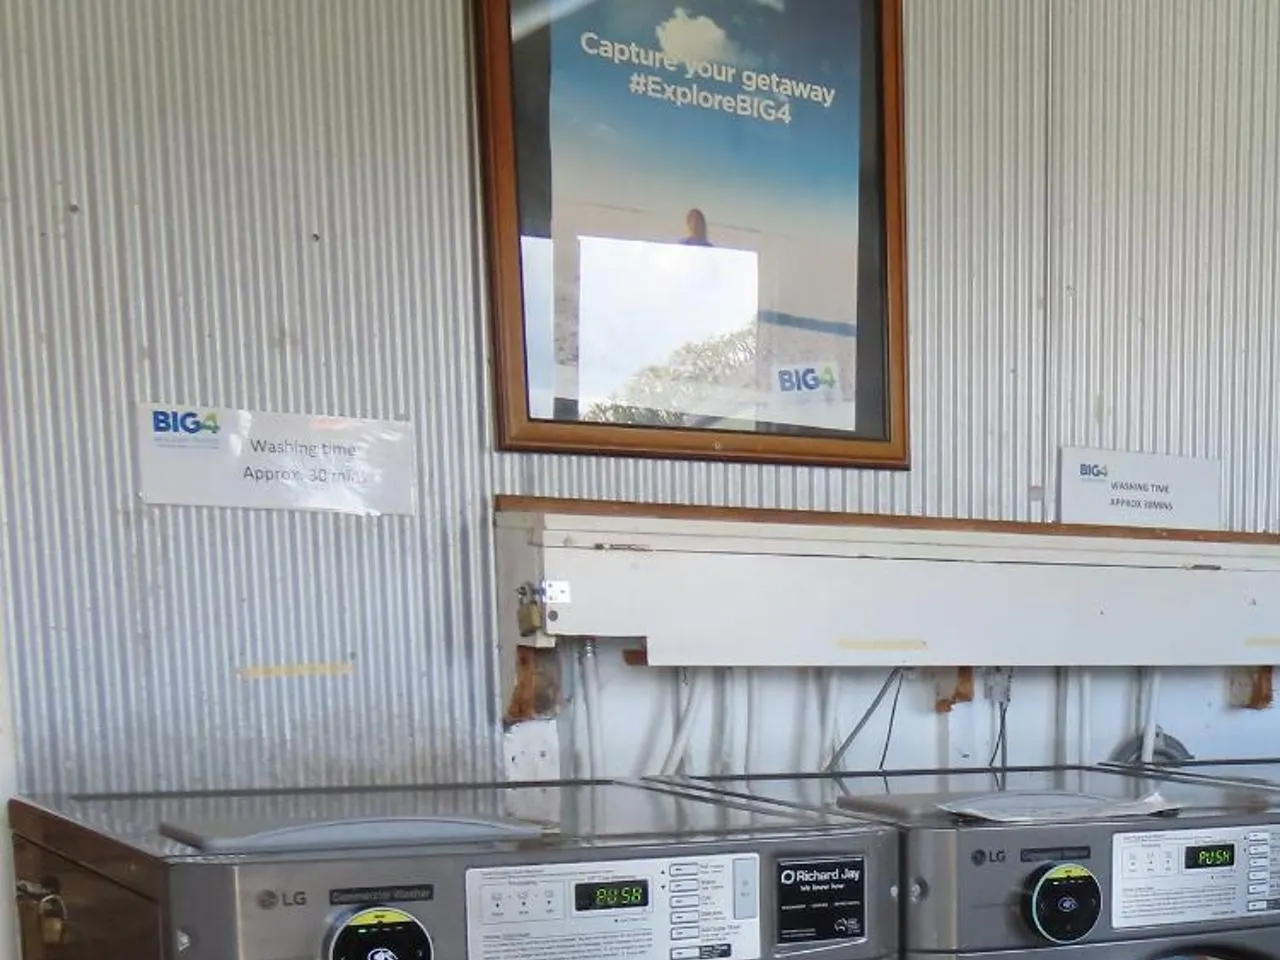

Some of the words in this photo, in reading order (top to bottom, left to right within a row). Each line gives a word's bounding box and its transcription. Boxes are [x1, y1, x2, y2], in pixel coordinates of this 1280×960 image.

[580, 31, 677, 71] Capture
[682, 57, 736, 84] your
[741, 68, 836, 108] getaway
[629, 72, 793, 124] #ExploreBIG4
[777, 366, 837, 392] BIG4
[152, 410, 220, 434] BIG4
[250, 438, 318, 458] Washing
[1079, 464, 1108, 477] BIG4
[1111, 481, 1149, 493] WASHING
[1150, 483, 1170, 493] TIME
[1109, 498, 1142, 509] APPROX
[988, 851, 1007, 862] LG
[1198, 850, 1230, 865] PUSH
[796, 867, 839, 882] Richard
[841, 867, 860, 881] Jay
[281, 891, 308, 906] LG
